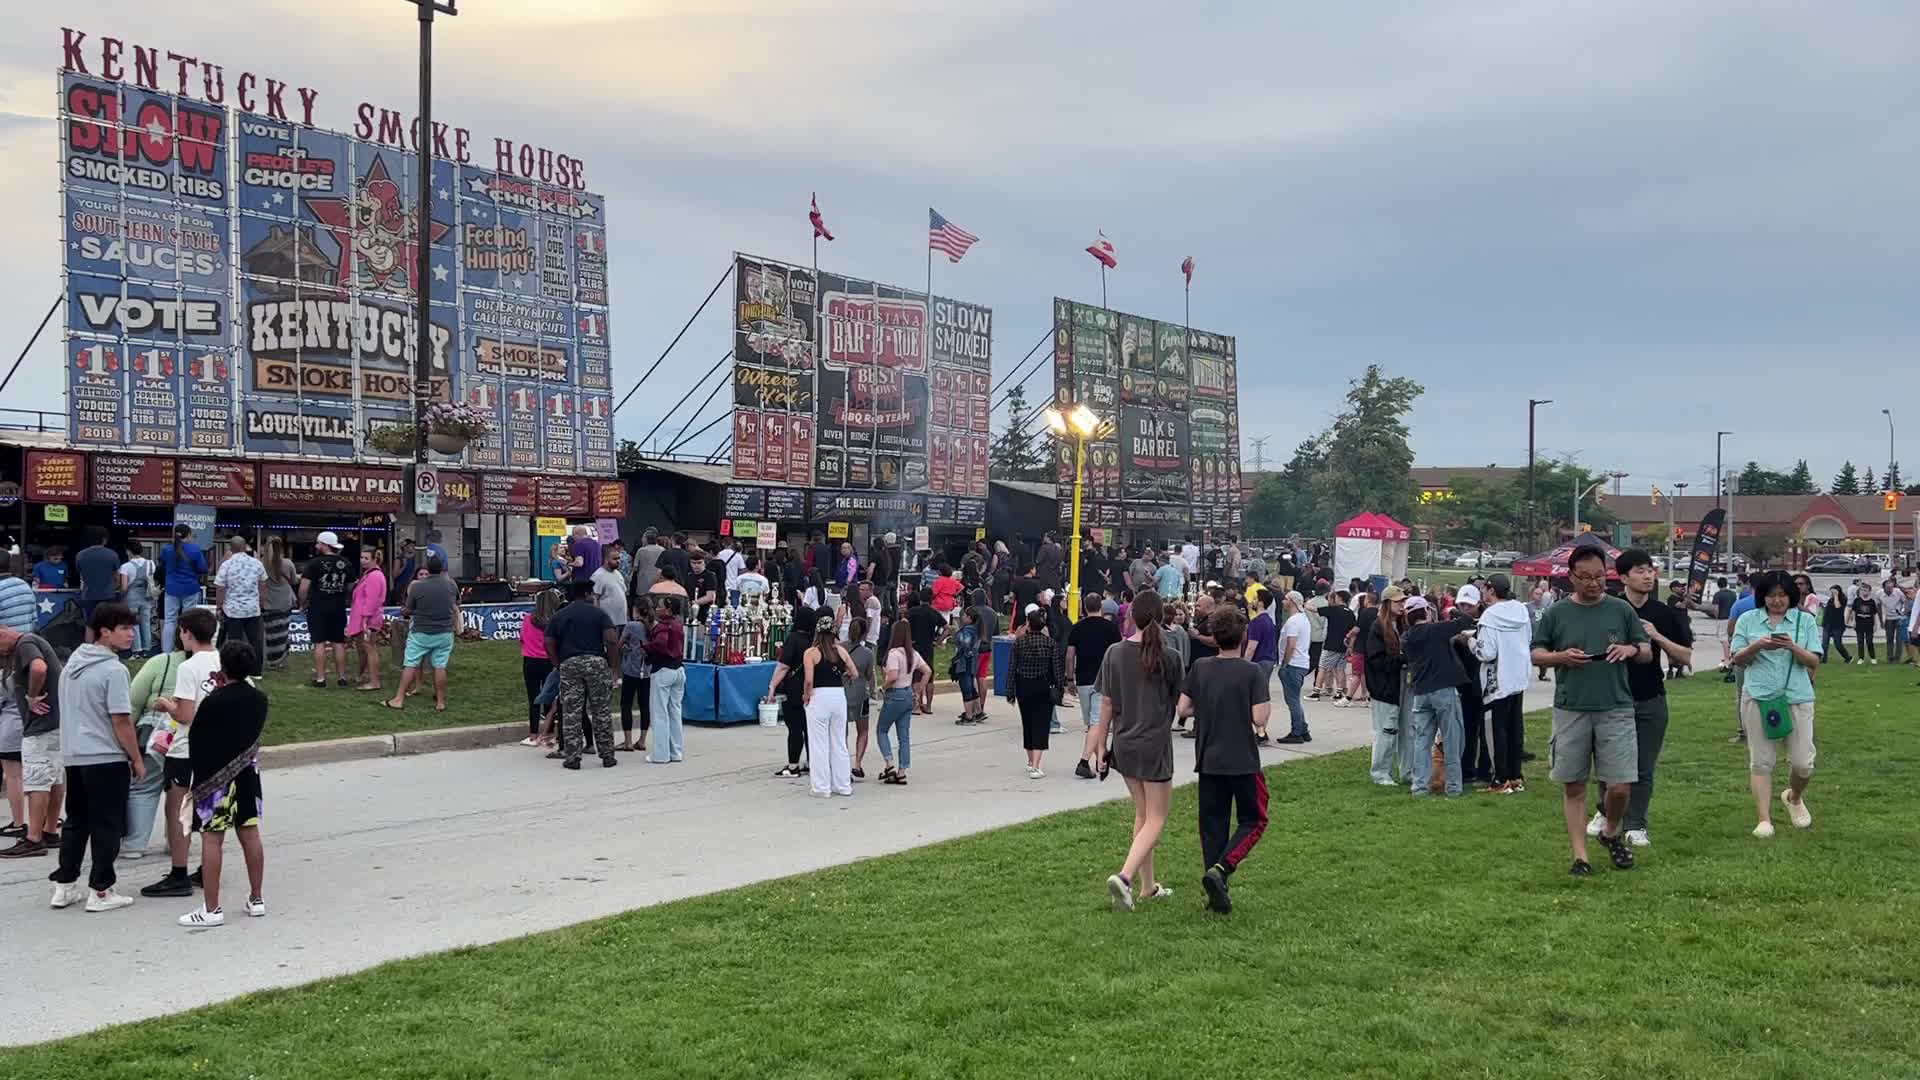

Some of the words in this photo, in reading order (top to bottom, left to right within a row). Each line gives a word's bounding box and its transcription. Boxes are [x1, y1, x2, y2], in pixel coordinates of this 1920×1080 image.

[60, 27, 319, 126] KENTUCKY
[354, 102, 470, 164] SMOKE
[494, 137, 586, 190] HOUSE
[68, 84, 222, 174] SLOW
[242, 122, 290, 140] VOTE
[278, 146, 307, 159] FOR
[69, 158, 168, 190] SMOKED
[172, 174, 223, 199] RIBS
[244, 168, 333, 190] CHOICE
[489, 189, 582, 219] CHICKEN
[76, 199, 118, 212] YOU'RE
[123, 206, 160, 219] ONNA
[192, 218, 214, 229] OUR
[72, 212, 164, 243] SOUTHERN
[168, 228, 221, 252] STYLE
[465, 223, 528, 250] Feeling
[547, 224, 564, 239] TRY
[80, 236, 214, 276] SAUCES
[546, 240, 565, 254] OUR
[465, 247, 537, 276] Hungry?
[545, 255, 567, 271] HILL
[543, 270, 568, 286] BILLY
[791, 279, 815, 292] VOTE
[78, 294, 217, 331] VOTE
[474, 299, 514, 313] BUTTER
[515, 304, 530, 316] MY
[557, 311, 564, 320] &
[833, 305, 920, 326] LOUISIANA
[935, 302, 990, 333] SLOW
[473, 312, 497, 325] CALL
[514, 318, 522, 328] A
[251, 299, 449, 370] KENTUCKY
[935, 327, 988, 359] SMOKED
[492, 346, 557, 366] SMOKED
[477, 363, 529, 377] PULLED
[530, 367, 567, 382] PORK
[737, 368, 800, 387] Where
[79, 376, 116, 387] PLACE
[136, 380, 171, 390] PLACE
[192, 384, 225, 394] PLACE
[267, 364, 352, 390] SMOKE
[364, 373, 442, 398] HOUE
[79, 411, 114, 423] SAUCE
[193, 419, 225, 430] SAUCE
[248, 412, 353, 439] LOUISVILLE
[841, 412, 862, 424] BBQ
[885, 412, 910, 423] TEAM
[850, 432, 870, 441] RIDGE
[1140, 419, 1165, 437] OAK
[1168, 422, 1176, 437] &
[1133, 437, 1180, 458] BARREL
[269, 473, 360, 492] HILLBILLY
[835, 497, 851, 509] THE
[853, 498, 876, 510] BELLY
[1348, 527, 1370, 537] ATM
